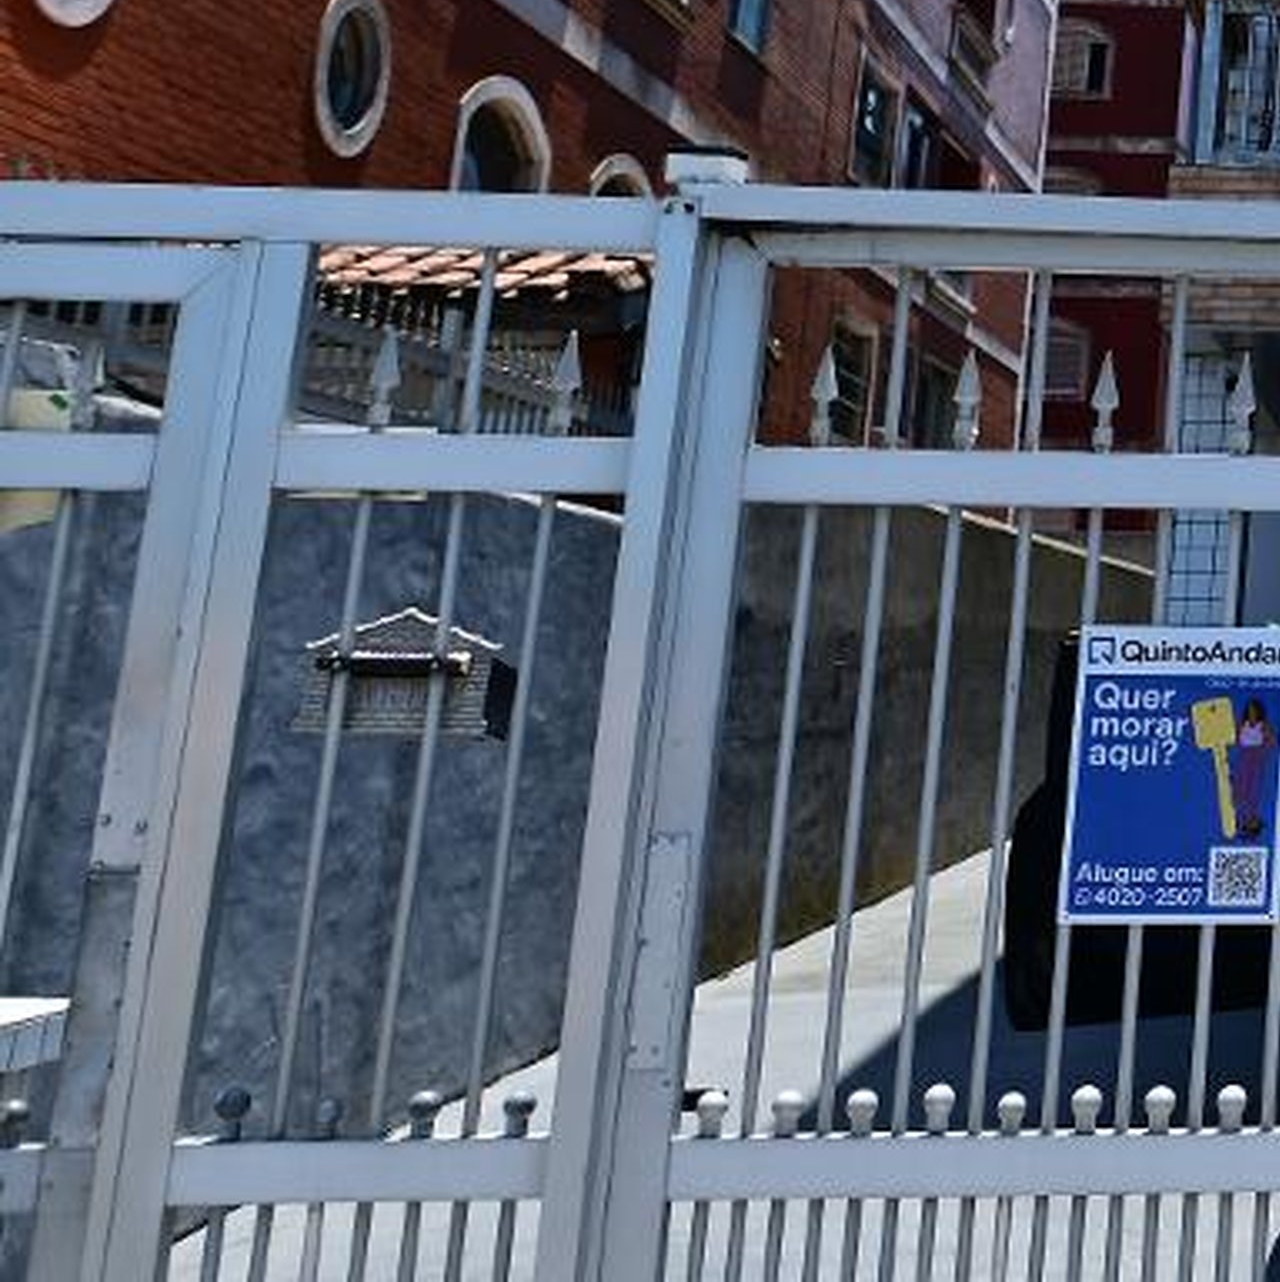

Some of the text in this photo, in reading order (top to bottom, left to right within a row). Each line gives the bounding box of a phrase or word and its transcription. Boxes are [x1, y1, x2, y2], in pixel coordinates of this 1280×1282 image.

[1094, 682, 1176, 710] Quer
[1090, 717, 1187, 738] morar
[1088, 740, 1178, 770] aqui?
[1075, 862, 1158, 886] Alugue
